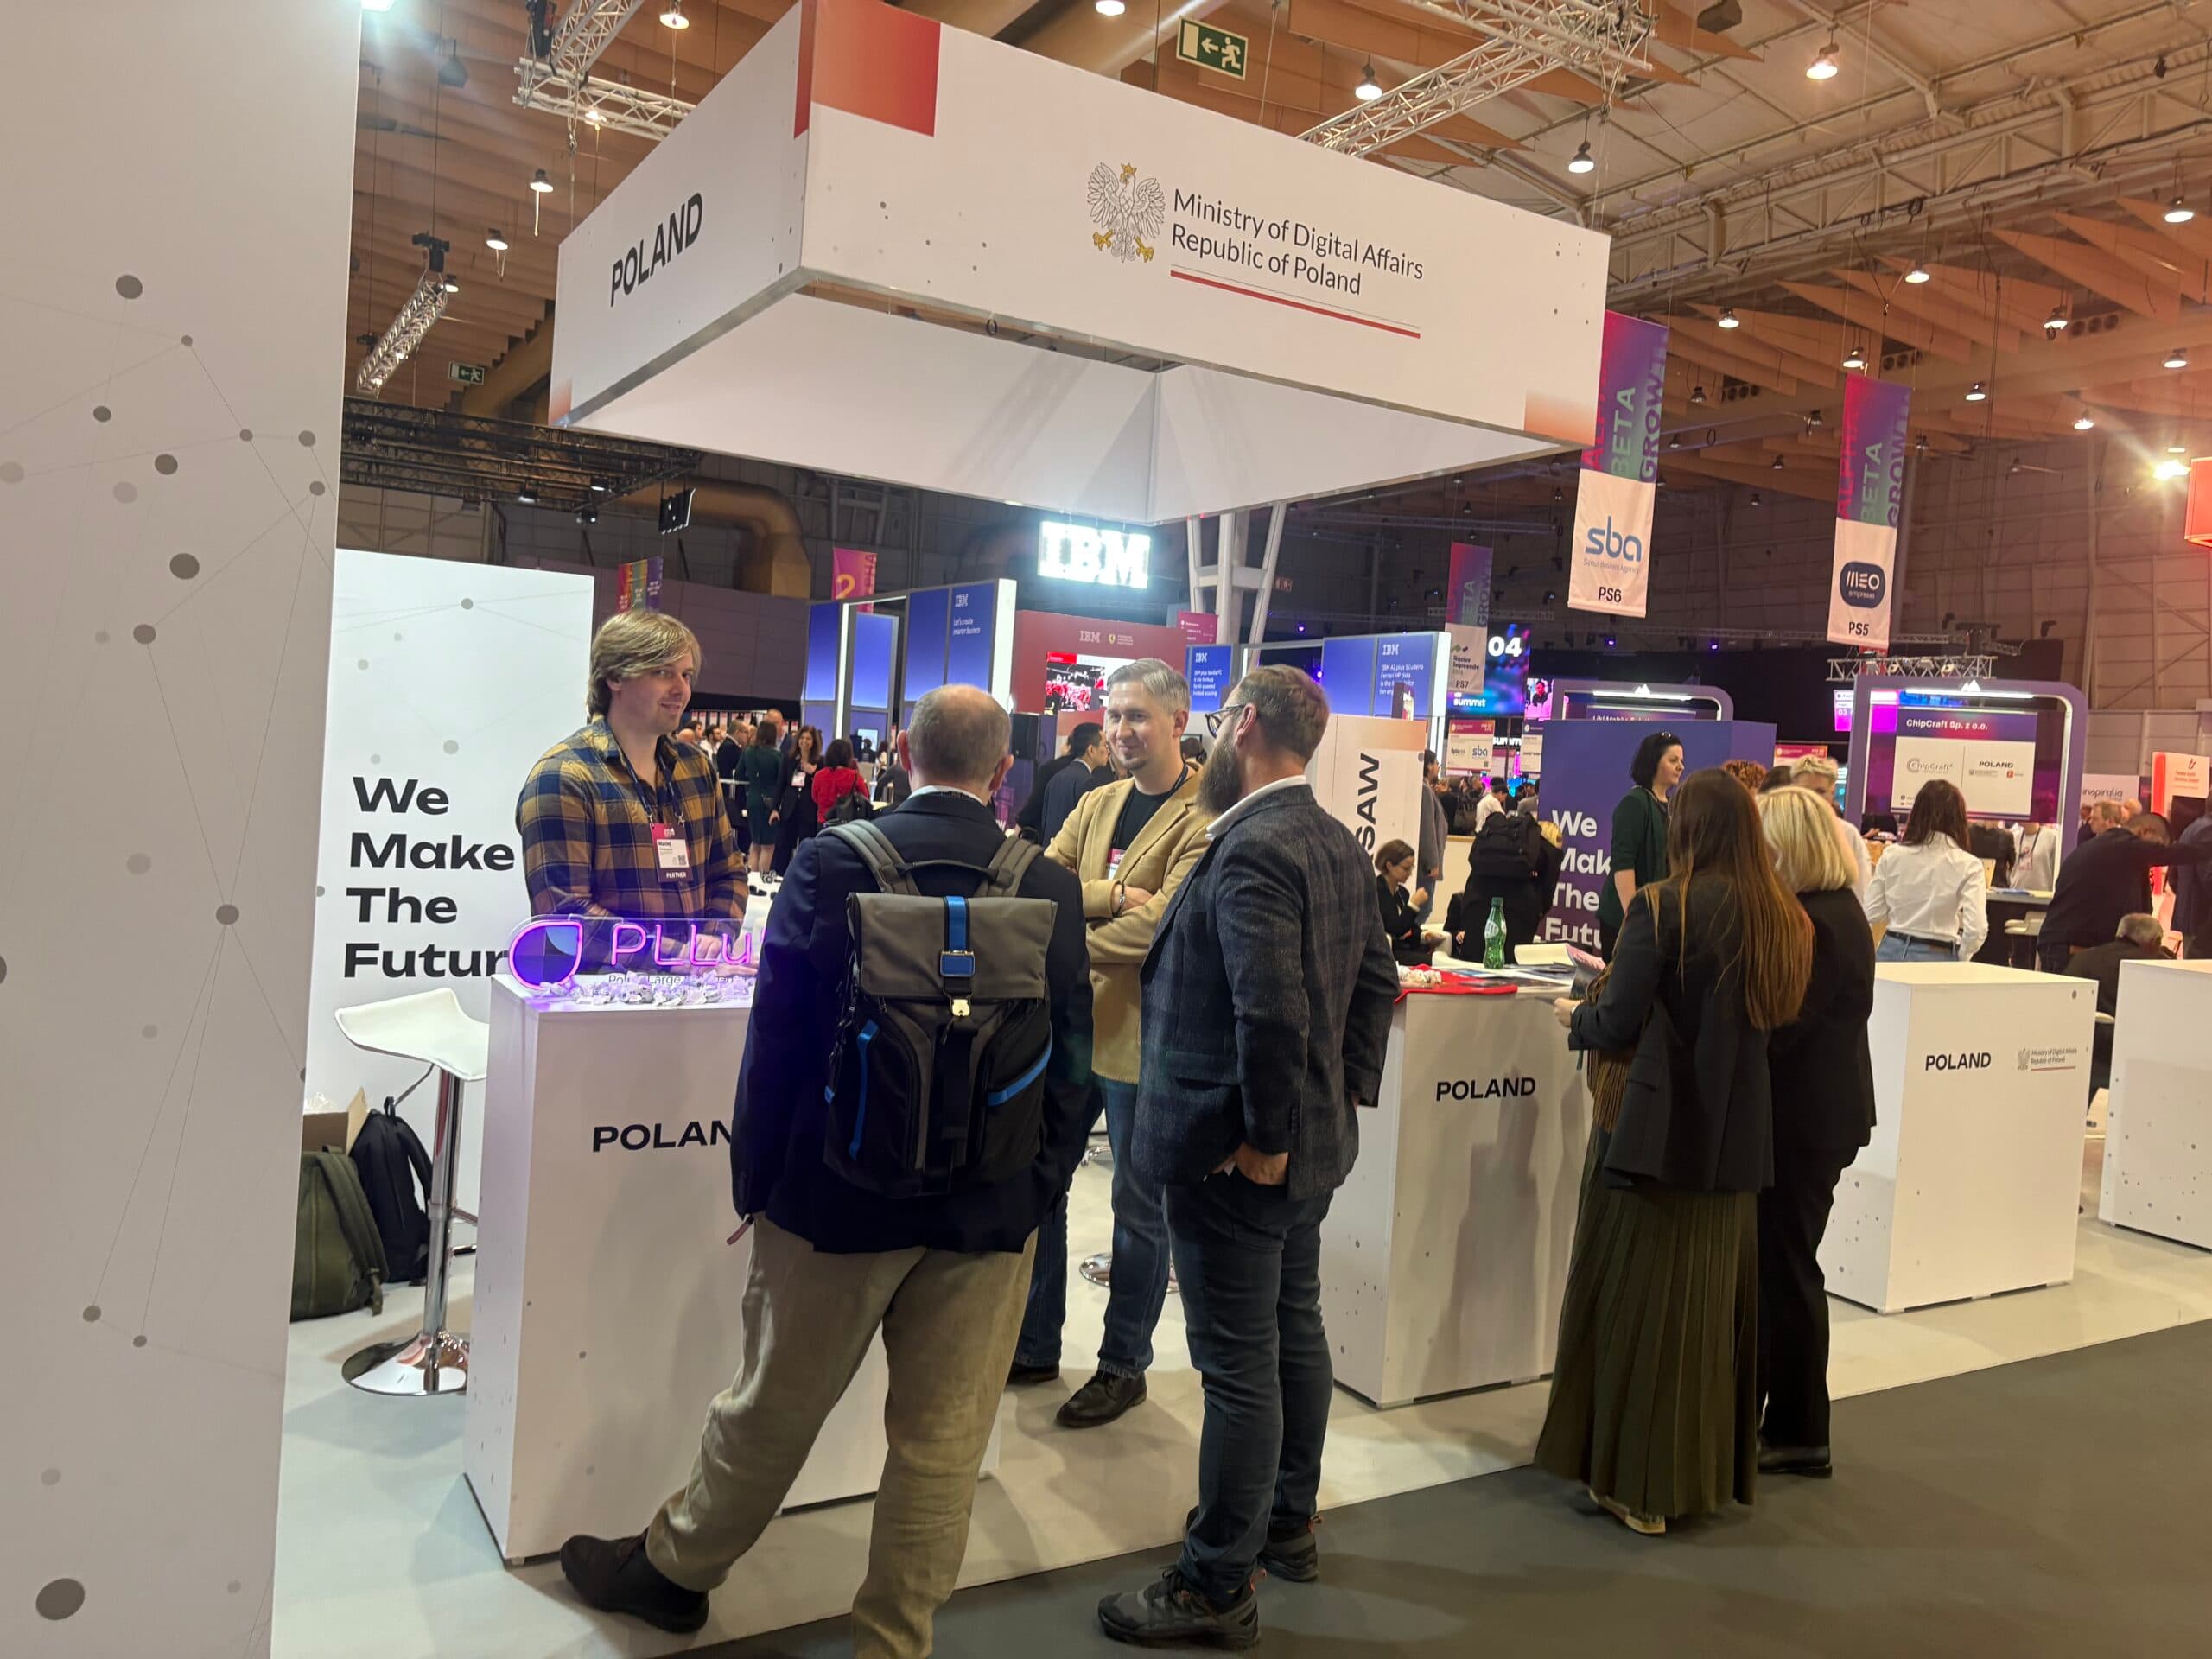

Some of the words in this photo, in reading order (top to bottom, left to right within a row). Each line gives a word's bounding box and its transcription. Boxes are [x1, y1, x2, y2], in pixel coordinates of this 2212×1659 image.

[1173, 188, 1264, 238] Ministry
[1268, 219, 1291, 242] of
[1294, 223, 1359, 263] Digital
[1363, 244, 1424, 280] Affairs
[611, 193, 702, 307] POLAND
[1172, 223, 1264, 269] Republic
[1268, 254, 1290, 276] of
[1294, 257, 1361, 296] Poland
[1611, 387, 1636, 474] BETA
[1585, 515, 1643, 563] sba
[1039, 521, 1151, 589] IBM
[1846, 570, 1880, 590] MEO
[1598, 587, 1622, 602] PS6
[1079, 630, 1101, 644] IBM
[1848, 621, 1870, 636] PS5
[1382, 643, 1400, 656] IBM
[1488, 636, 1522, 658] 04
[1455, 680, 1469, 690] PS7
[1453, 697, 1486, 708] summit
[1906, 719, 1948, 729] ChipCraft
[1472, 744, 1488, 757] sba
[1979, 760, 2014, 769] POLAND
[353, 776, 449, 815] We
[1552, 810, 1598, 838] We
[349, 832, 515, 871] Make
[346, 887, 458, 925] The
[1552, 882, 1600, 912] The
[611, 924, 766, 966] PLLu
[344, 943, 508, 979] Futur
[1925, 1052, 1992, 1071] POLAND
[1436, 1077, 1536, 1102] POLAND
[593, 1120, 732, 1153] POLAN
